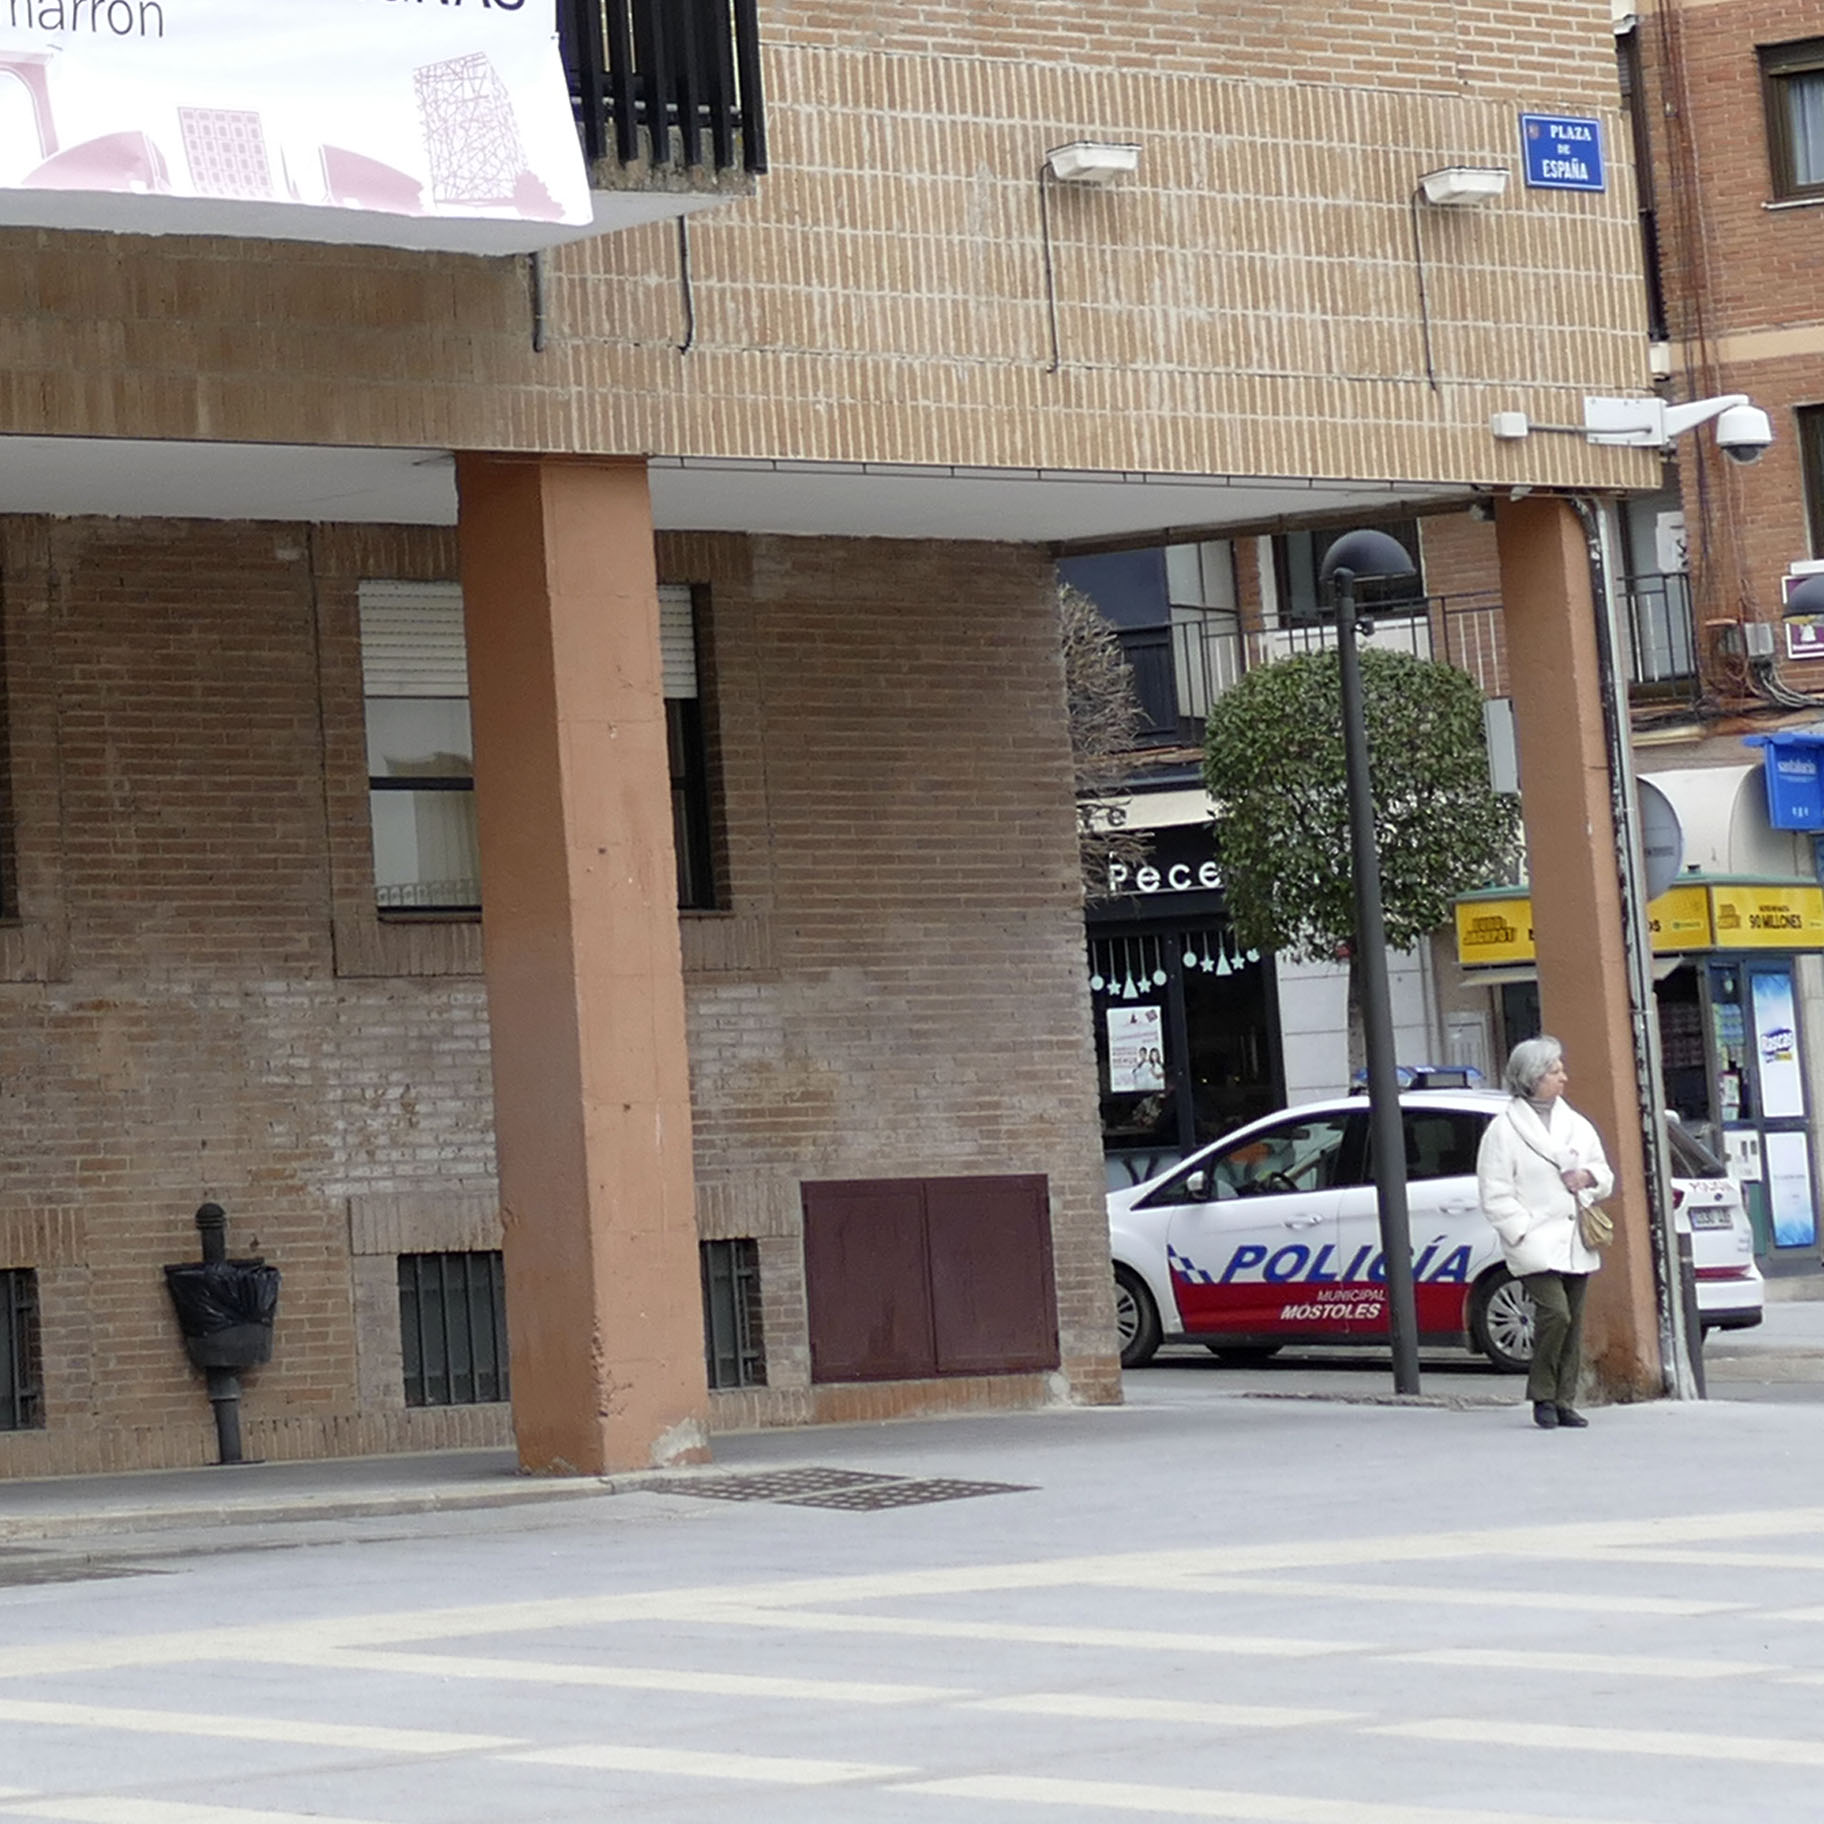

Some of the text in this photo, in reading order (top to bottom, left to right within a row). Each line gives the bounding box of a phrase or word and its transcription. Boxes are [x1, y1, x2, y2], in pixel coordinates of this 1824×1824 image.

[1549, 124, 1592, 141] PLAZA
[1556, 144, 1571, 155] DE
[1541, 158, 1589, 181] ESPAÑA
[1317, 1289, 1387, 1302] MUNICIPAL
